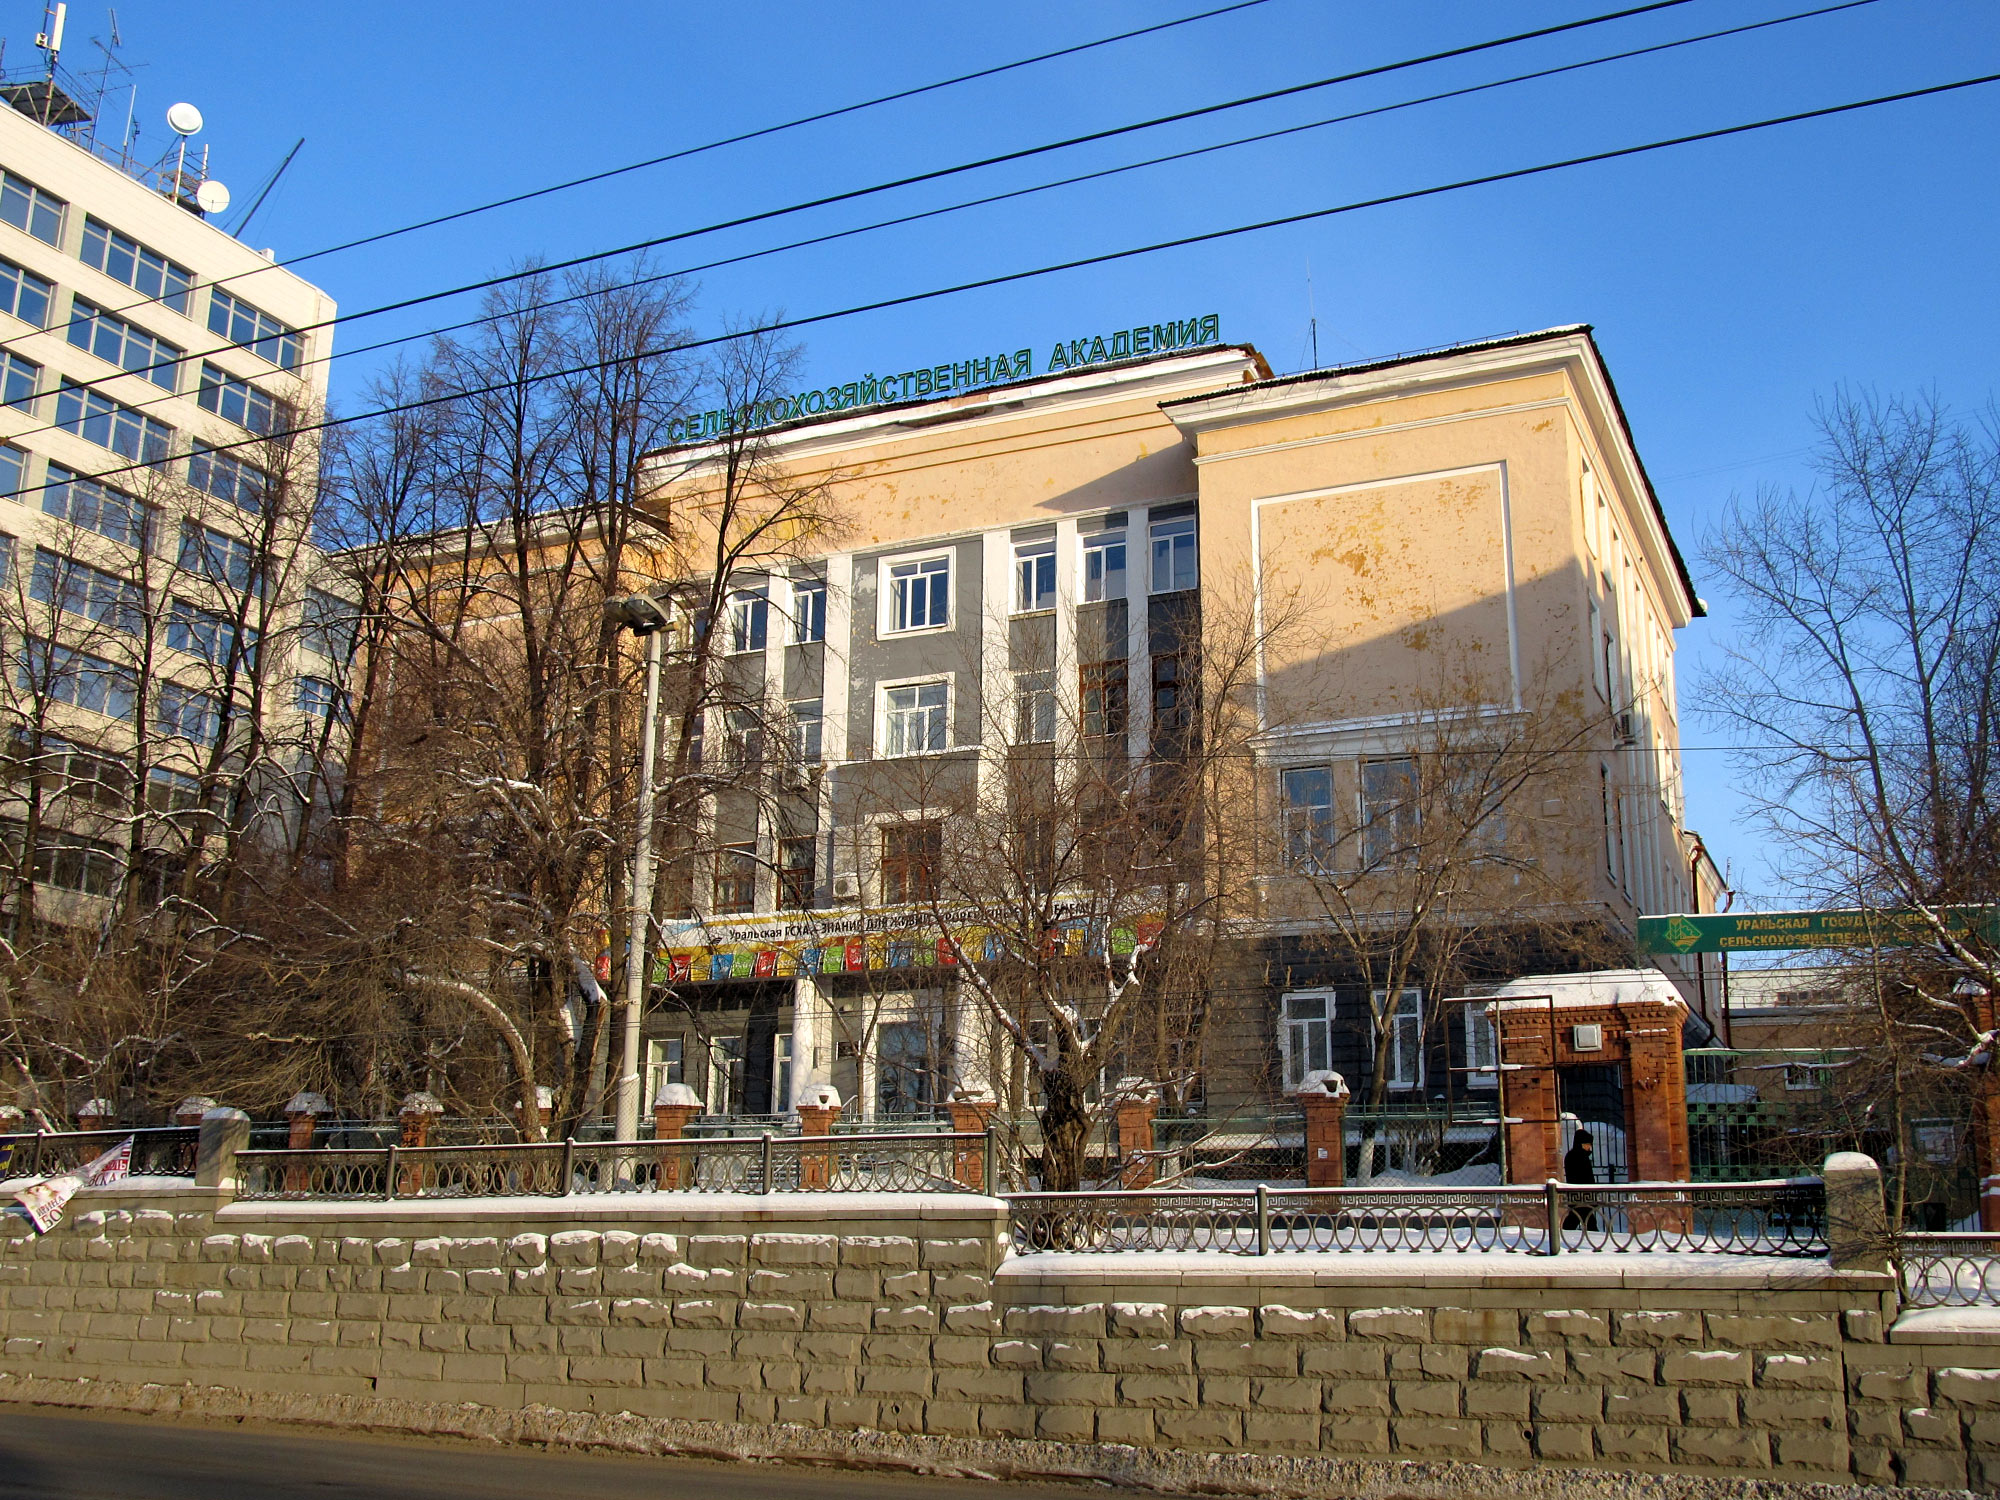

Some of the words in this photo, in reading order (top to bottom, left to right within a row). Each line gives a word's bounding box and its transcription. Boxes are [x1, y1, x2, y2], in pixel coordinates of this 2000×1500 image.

[667, 348, 1032, 441] СЕЛЬСКОХОЗЯЙСТВЕННАЯ
[1048, 313, 1221, 371] АКАДЕМИЯ
[729, 929, 782, 941] Уральская
[821, 919, 862, 933] ЗНАНИЯ
[1736, 917, 1810, 930] УРАЛЬСКАЯ
